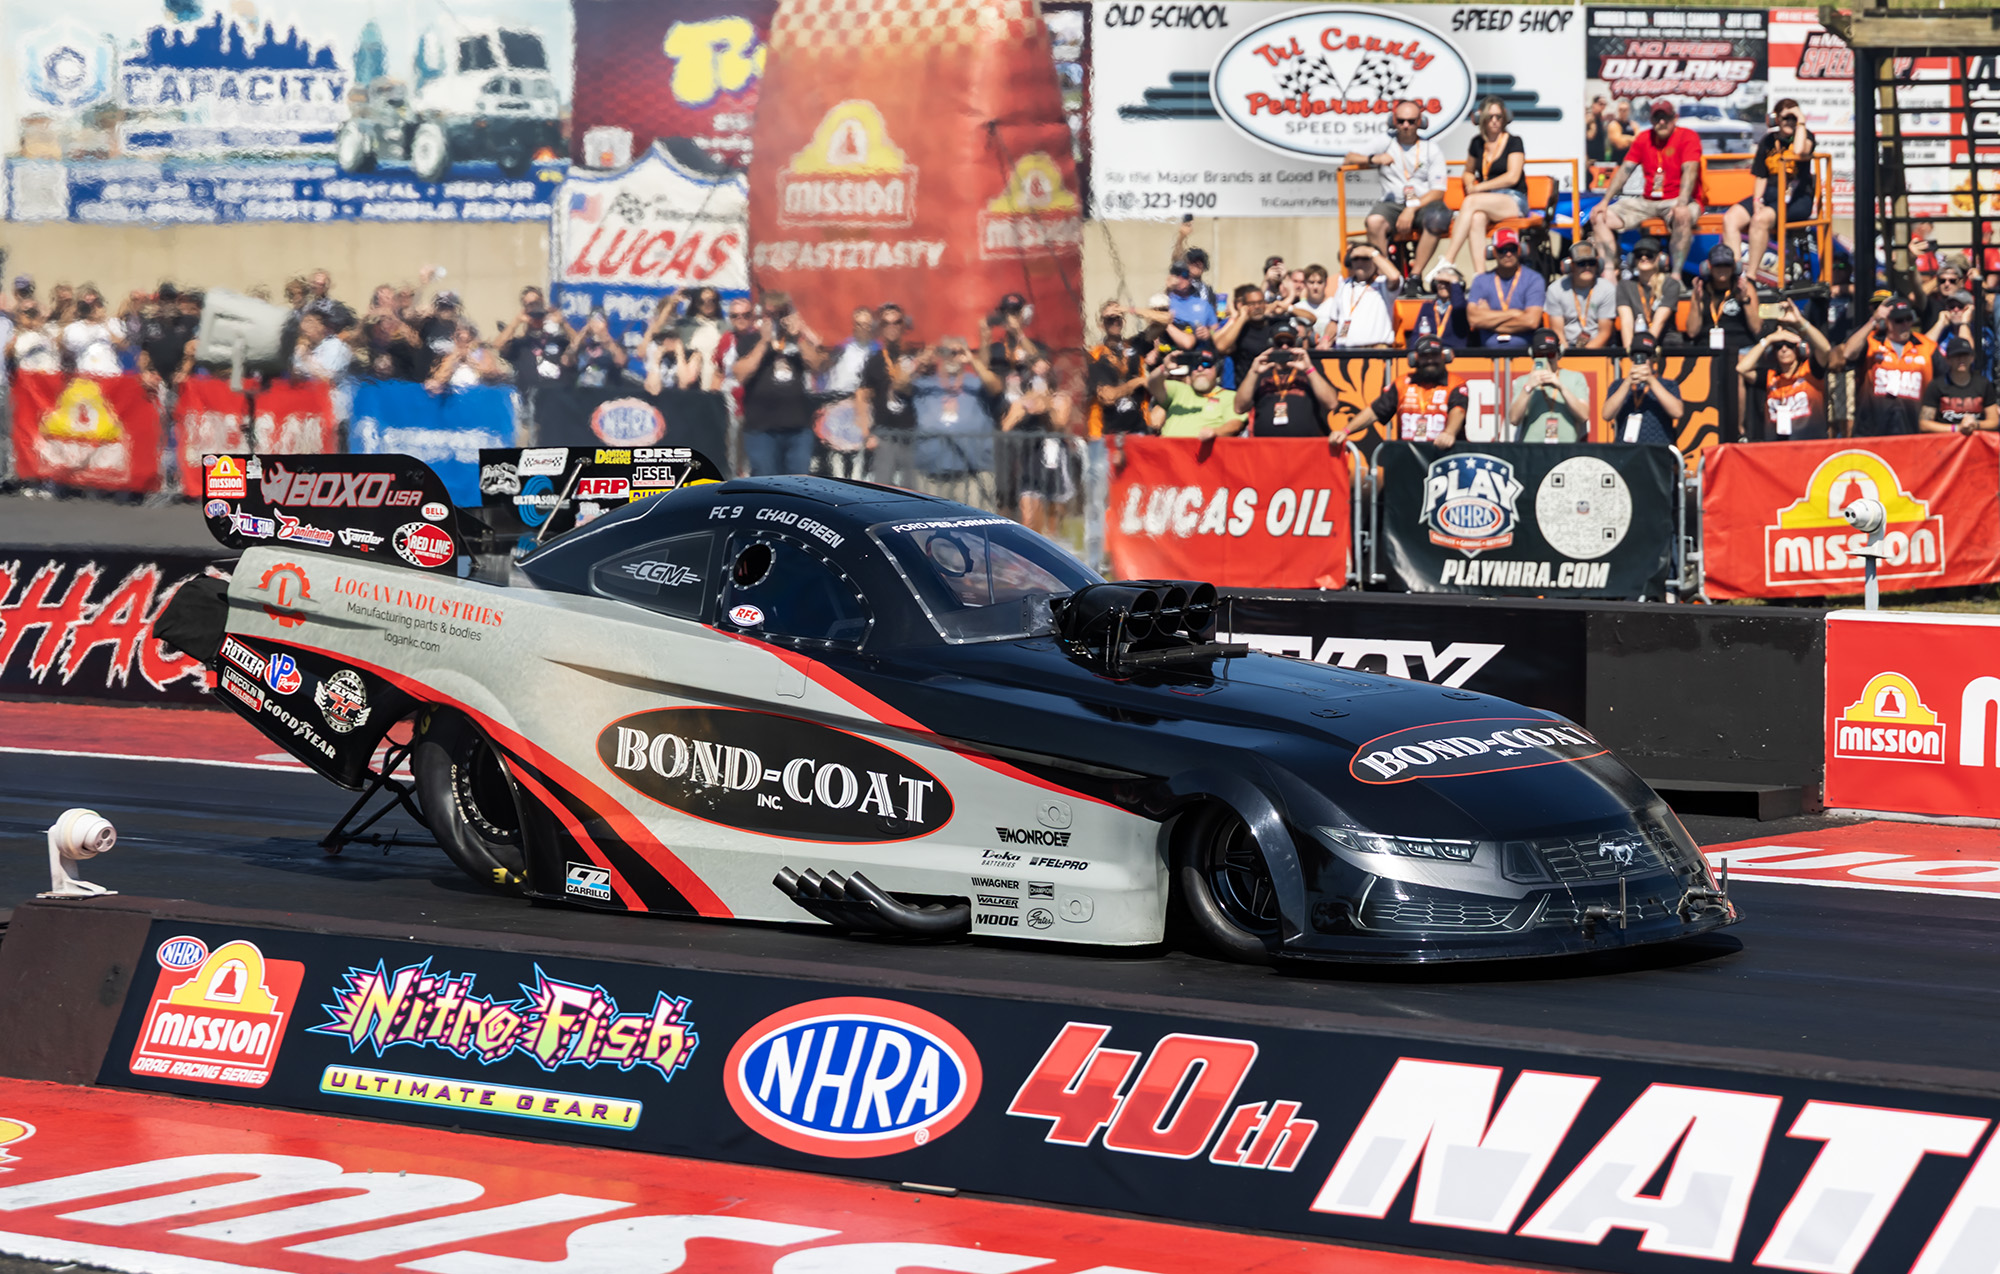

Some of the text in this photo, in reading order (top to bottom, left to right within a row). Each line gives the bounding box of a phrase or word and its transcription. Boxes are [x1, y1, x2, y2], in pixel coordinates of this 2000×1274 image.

[1104, 5, 1229, 29] OLD SCHOOL
[1452, 8, 1513, 32] SPEED
[1519, 9, 1574, 33] SHOP
[1252, 26, 1436, 71] Tri County
[1626, 41, 1732, 57] NO PREP
[1602, 58, 1755, 81] OUTLAWS
[123, 73, 348, 104] CAPACITY
[1285, 120, 1389, 135] SPEED SHO
[1156, 170, 1199, 185] Major
[1203, 169, 1254, 184] Brands
[1258, 170, 1272, 183] at
[1276, 169, 1314, 184] Good
[566, 227, 739, 280] LUCAS
[209, 477, 242, 488] MISSION
[633, 467, 676, 481] JESEL
[285, 473, 424, 507] BOXO USA
[576, 479, 628, 495] ARP
[1424, 467, 1520, 513] PLAY
[425, 507, 444, 516] BELL
[1120, 484, 1335, 538] LUCAS OIL
[1448, 505, 1494, 527] NHRA
[709, 505, 846, 549] FC 9 CHAD GREEN
[891, 521, 929, 534] FORD
[410, 535, 452, 556] RED LINE
[1773, 527, 1938, 574] MISSON
[635, 560, 687, 586] CGM
[1439, 558, 1610, 589] PLAYNHRA.COM
[334, 576, 504, 628] LOGAN INDUSTRIES
[735, 607, 759, 621] RFC
[346, 601, 482, 642] Manufacturing parts & bodies
[383, 629, 441, 653] logankc.com
[221, 636, 266, 680] ROTTLER
[225, 668, 258, 697] LINCOLN
[269, 653, 296, 691] VP
[263, 699, 337, 760] GOODYEAR
[1839, 725, 1941, 756] MISSION
[1357, 725, 1598, 780] BOND-COAT
[614, 725, 934, 825] BOND-COAT
[756, 792, 784, 811] INC.
[1004, 827, 1064, 847] MONROE
[980, 858, 1016, 869] BATTERIES
[981, 848, 1021, 862] Deka
[1036, 856, 1089, 871] FEL-PRO
[568, 866, 609, 887] CP
[980, 877, 1020, 890] WAGNER
[566, 884, 610, 900] CARRILLO
[977, 894, 1019, 909] WALKER
[1029, 886, 1054, 895] CHAMPION
[975, 913, 1020, 927] MOOG
[162, 941, 203, 966] NHRA
[345, 960, 698, 1081] Nitro Fish
[150, 1011, 271, 1056] MISSION
[132, 1056, 269, 1085] DRAG RACING SERIES
[758, 1025, 940, 1130] NHRA
[330, 1070, 497, 1107] ULTIMATE
[1007, 1020, 1319, 1173] 40th
